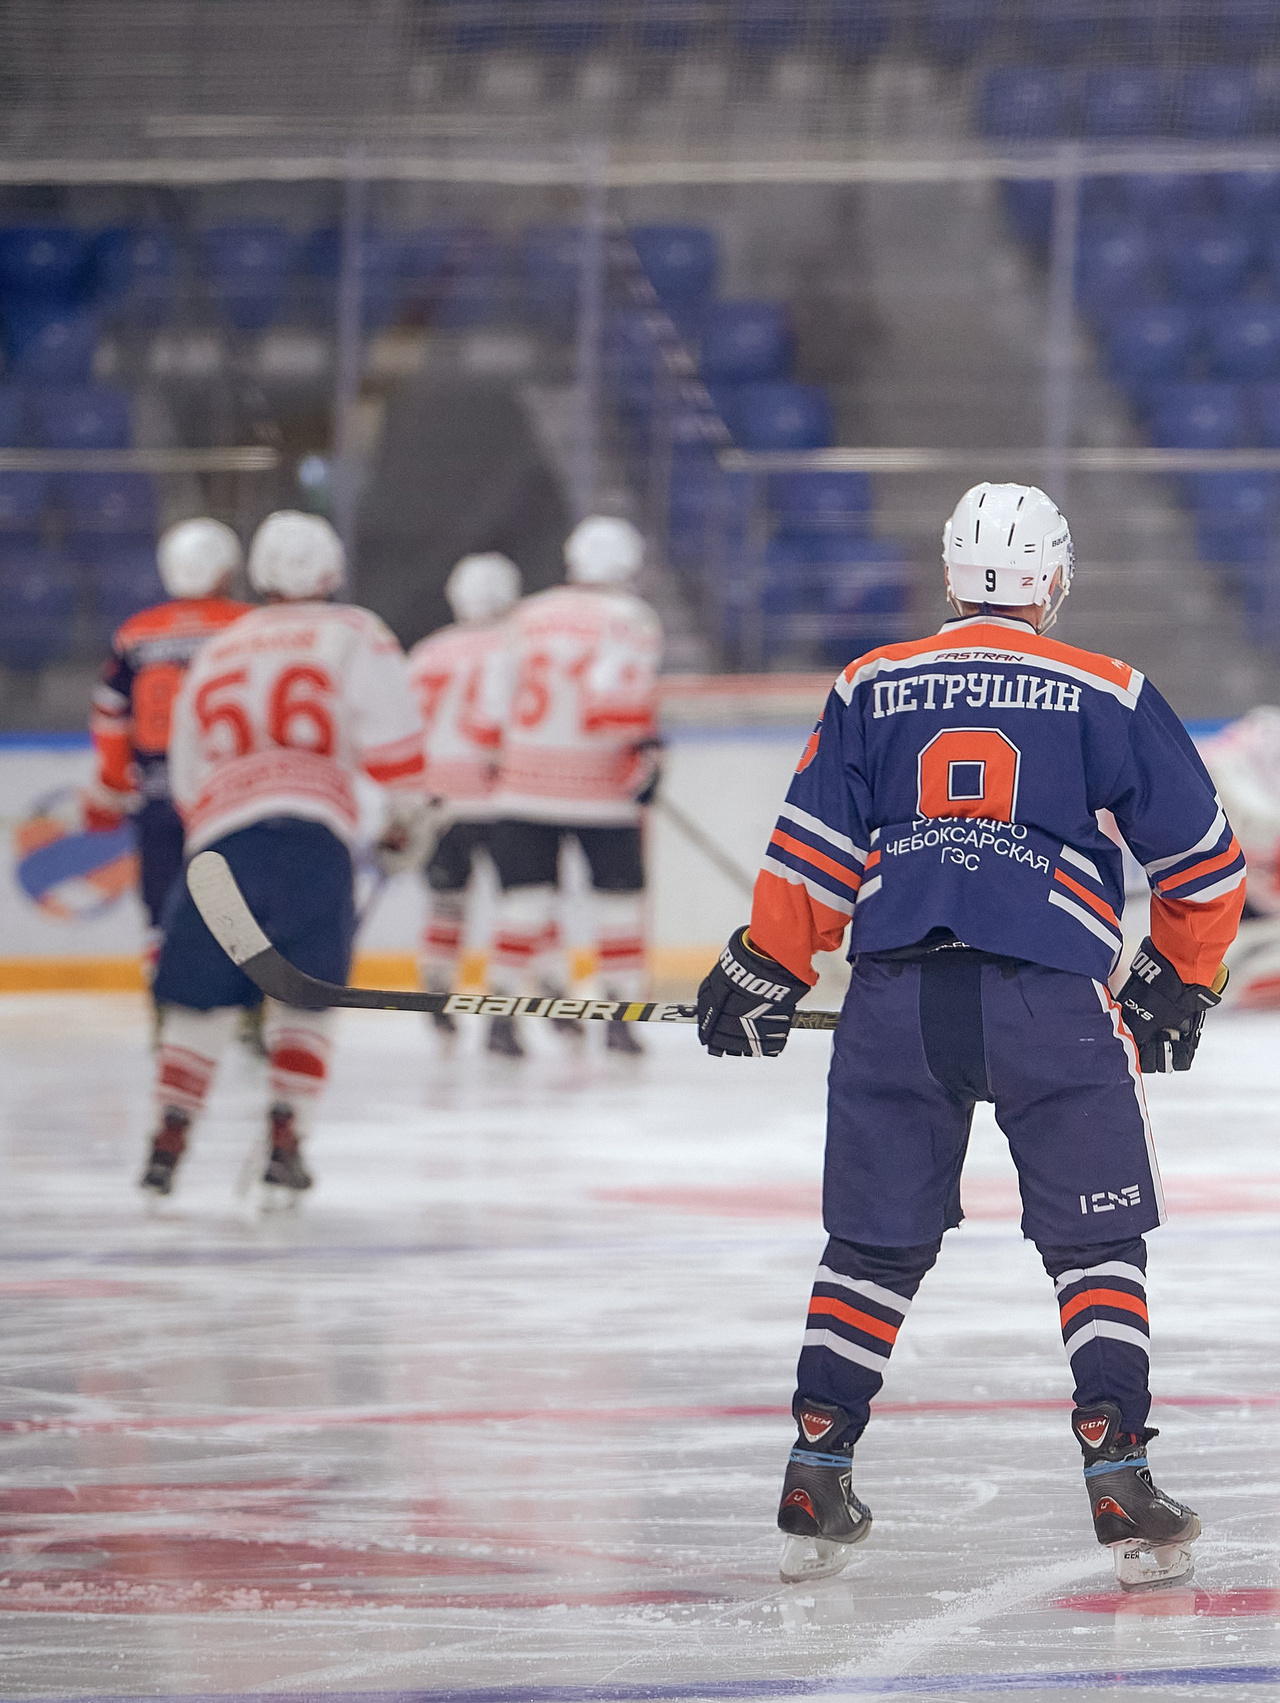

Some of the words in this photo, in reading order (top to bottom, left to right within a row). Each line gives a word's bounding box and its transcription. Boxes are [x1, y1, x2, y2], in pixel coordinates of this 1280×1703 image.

[985, 569, 996, 592] 9
[934, 651, 1024, 662] FASTRAN
[873, 673, 1082, 718] ПЕТРУШИН
[194, 662, 337, 757] 56
[886, 826, 1050, 874] ЧЕБОКСАРСКАЯ
[940, 846, 981, 871] ГЭС
[1080, 1418, 1107, 1431] CCM
